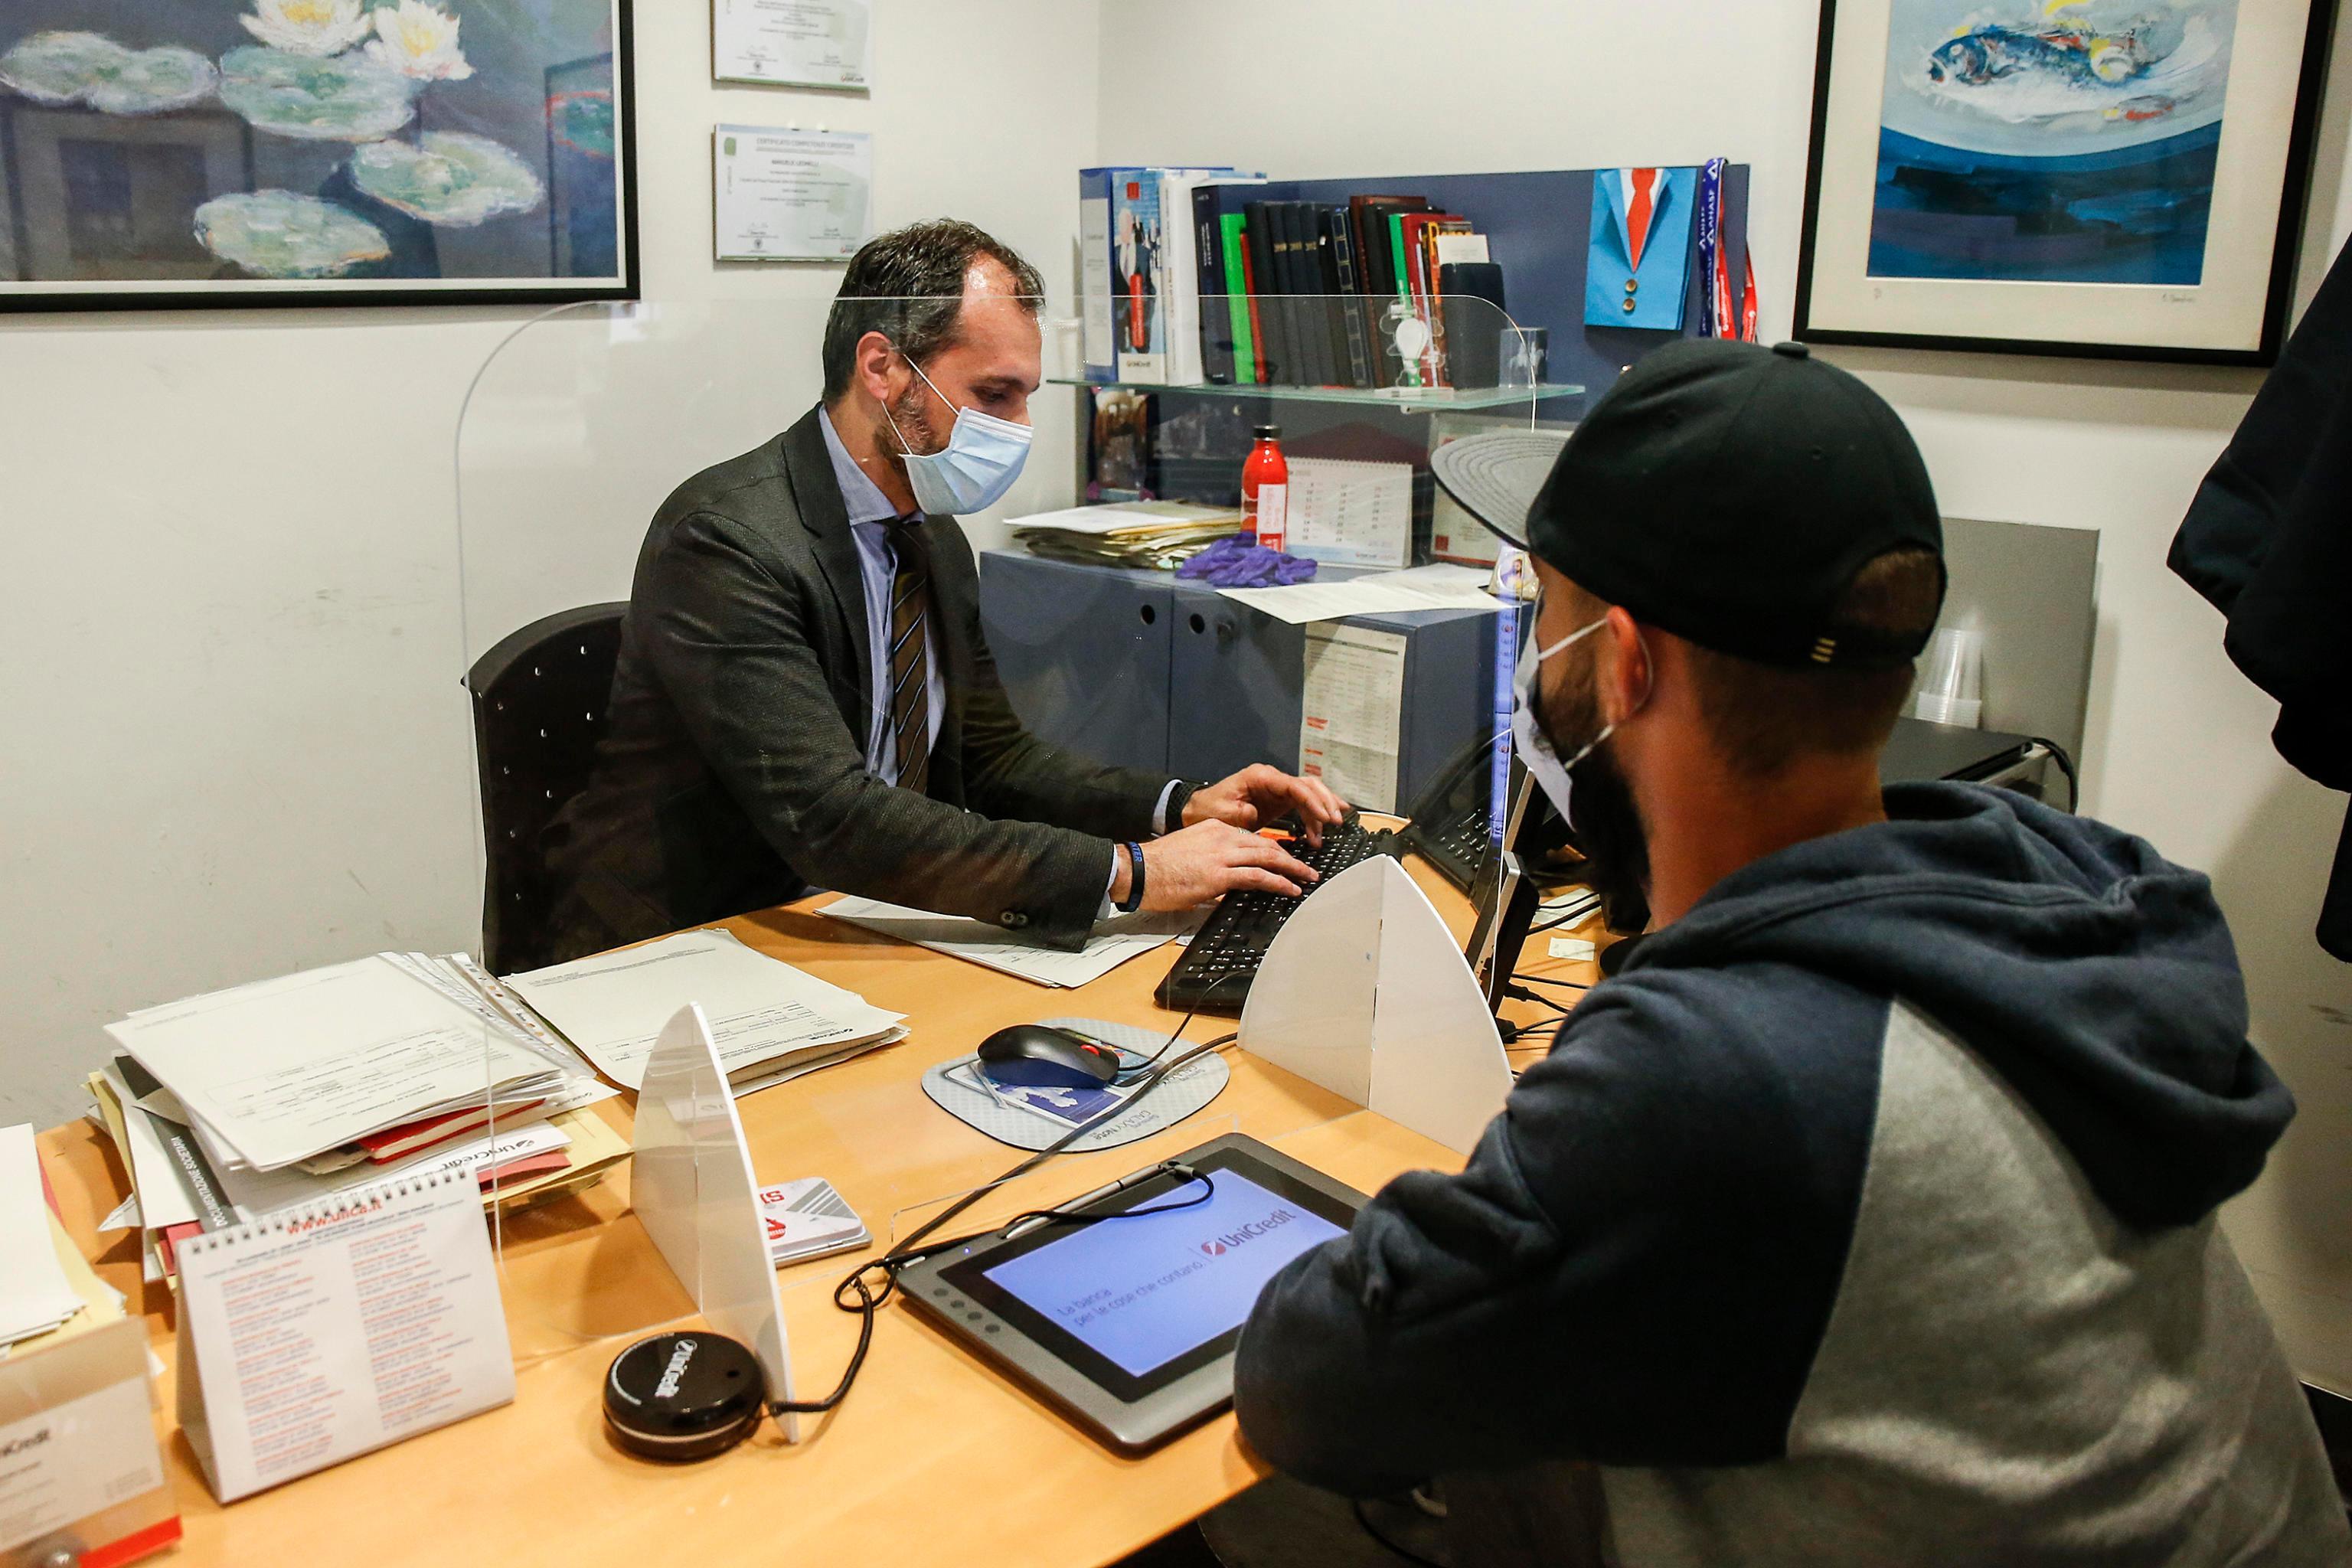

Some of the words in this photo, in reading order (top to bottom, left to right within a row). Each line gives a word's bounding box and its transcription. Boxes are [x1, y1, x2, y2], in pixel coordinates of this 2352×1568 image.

[171, 1135, 198, 1170] SOCIETARIA
[439, 1145, 517, 1170] UniCredit
[188, 1168, 228, 1227] DOCUMENTAZIONE
[1217, 1207, 1297, 1248] UniCredit
[1057, 1304, 1076, 1317] La
[1073, 1287, 1113, 1310] banca
[1073, 1312, 1094, 1328] per
[1093, 1304, 1107, 1318] le
[1108, 1292, 1135, 1310] cose
[1135, 1282, 1157, 1297] che
